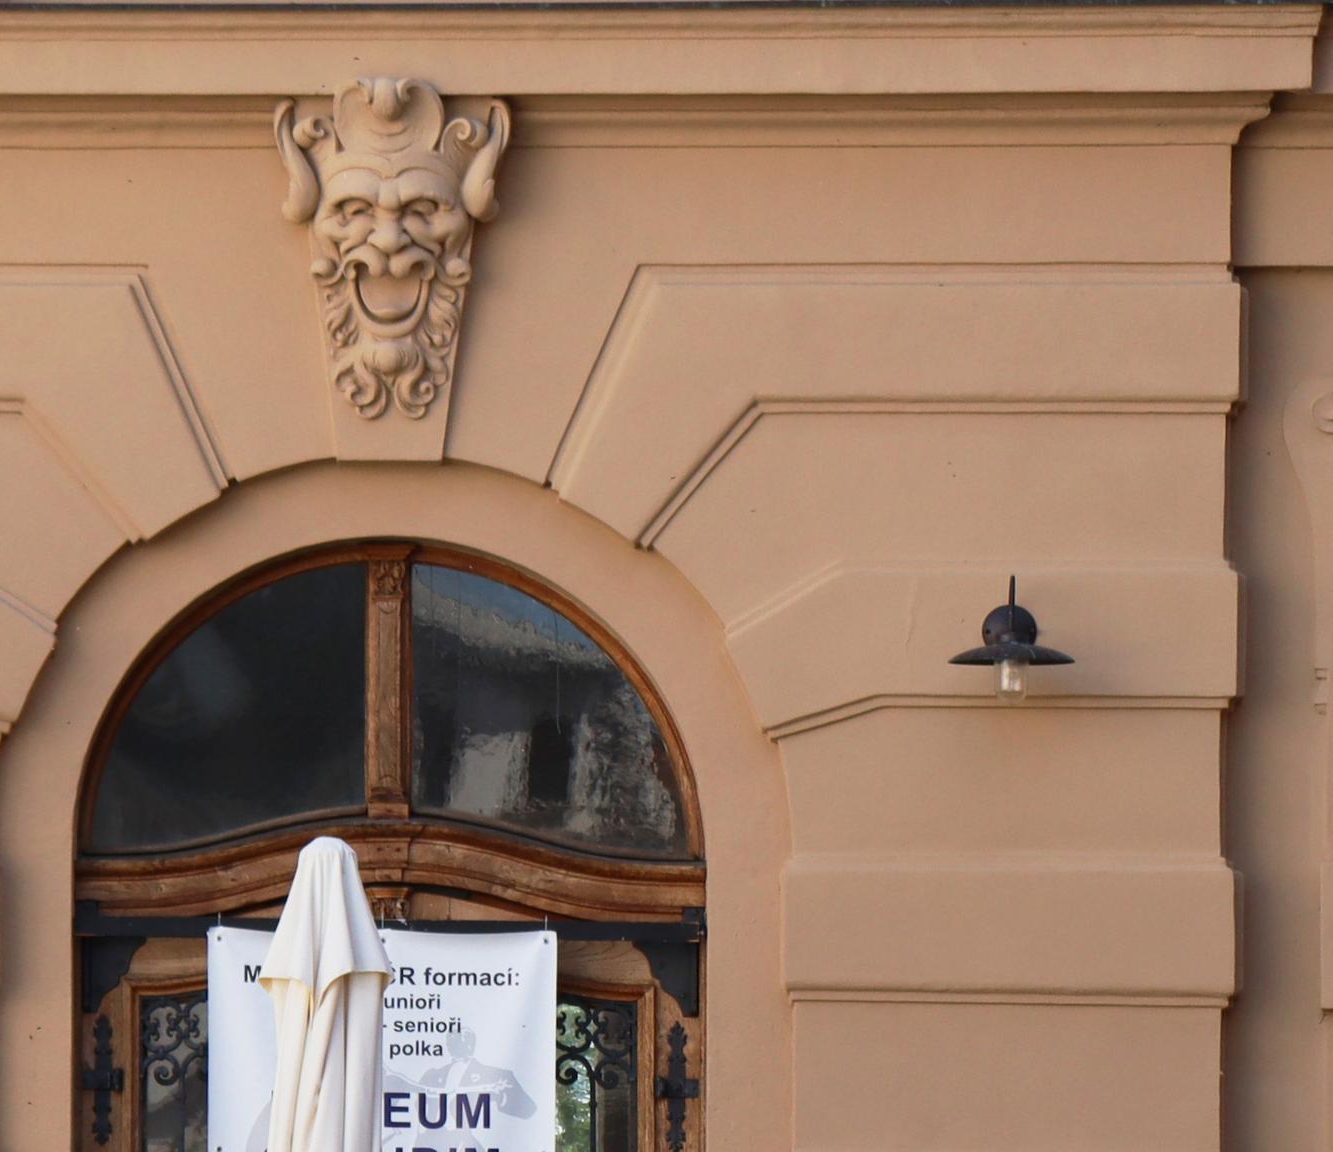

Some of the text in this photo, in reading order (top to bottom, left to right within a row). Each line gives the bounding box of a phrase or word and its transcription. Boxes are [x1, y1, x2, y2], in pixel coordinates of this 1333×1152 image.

[424, 967, 519, 986] formací:
[393, 1017, 461, 1033] senioři
[390, 1040, 443, 1059] polka
[384, 1092, 491, 1129] EUM
